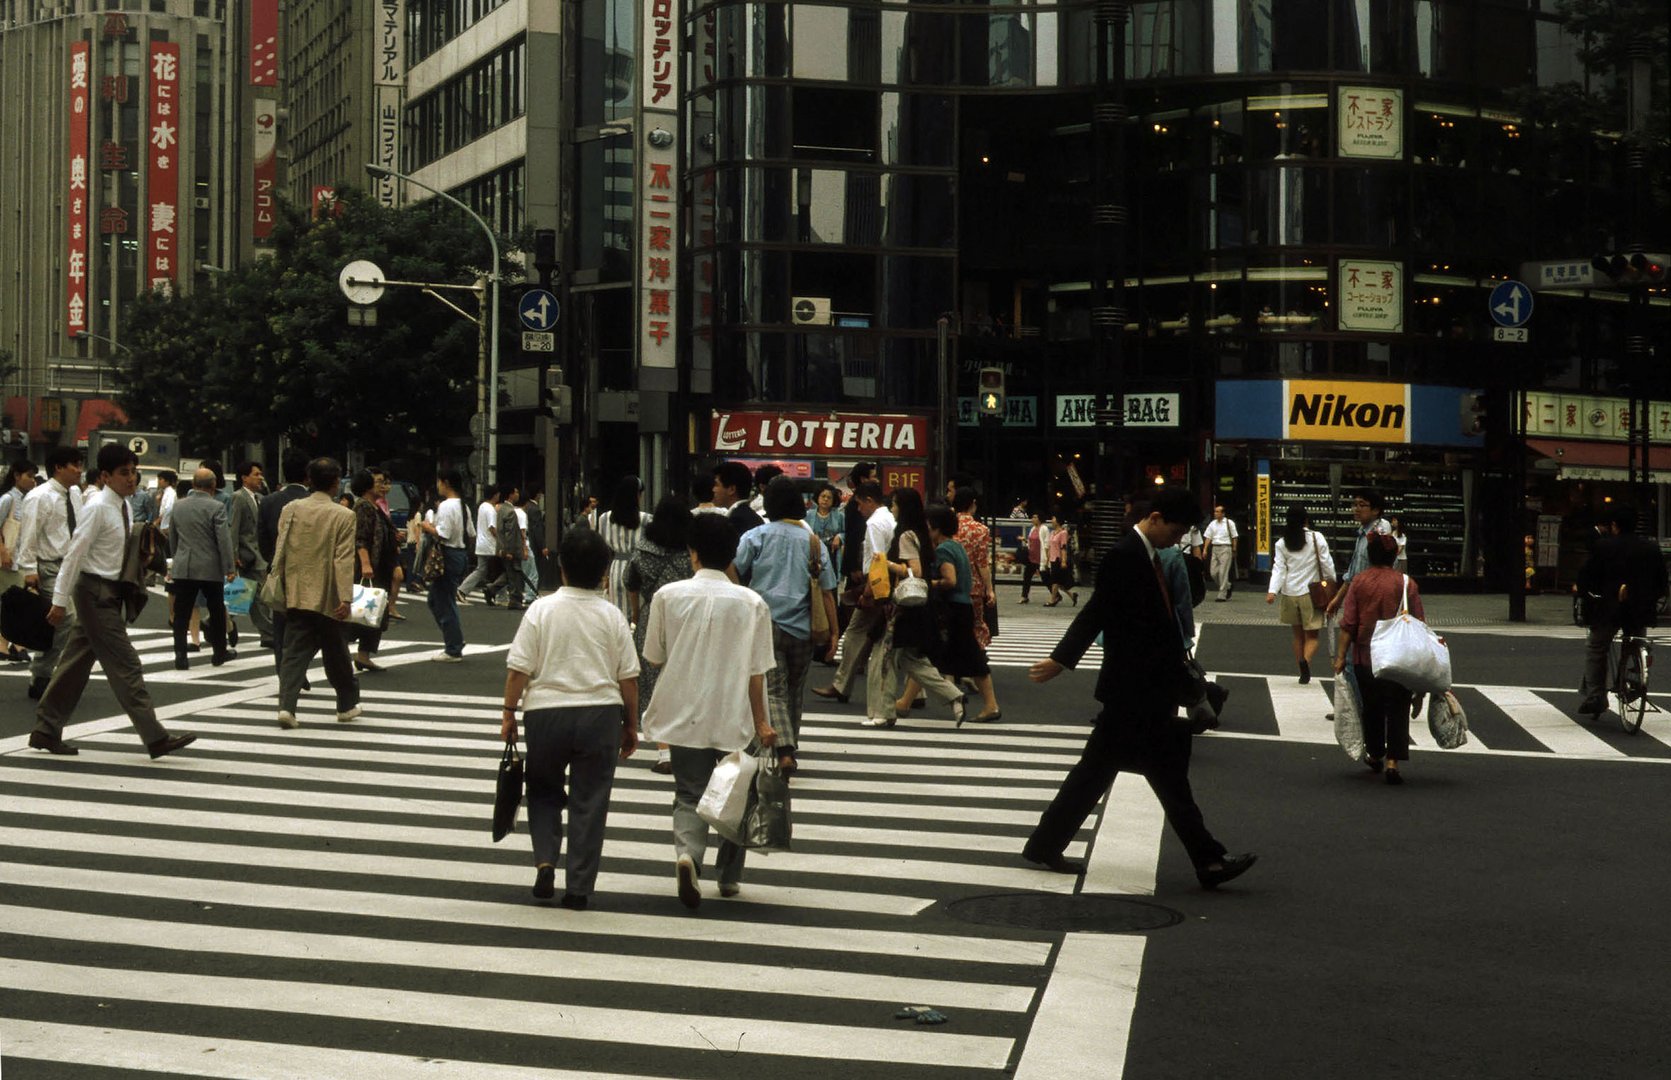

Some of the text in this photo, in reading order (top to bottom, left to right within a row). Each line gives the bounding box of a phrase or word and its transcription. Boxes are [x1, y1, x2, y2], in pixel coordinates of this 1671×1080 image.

[383, 0, 399, 81] マテリアル
[652, 0, 671, 103] ロッテリア
[151, 52, 176, 169] 花には水を
[1347, 95, 1394, 116] 不二家
[1347, 114, 1393, 131] レストラン
[257, 179, 272, 223] アコム
[69, 155, 86, 326] 奥さま年金
[649, 163, 671, 346] 不二家洋菓子
[1347, 268, 1394, 289] 不二家
[1127, 397, 1170, 422] BAG
[1289, 393, 1405, 429] Nikon
[758, 419, 915, 450] LOTTERIA
